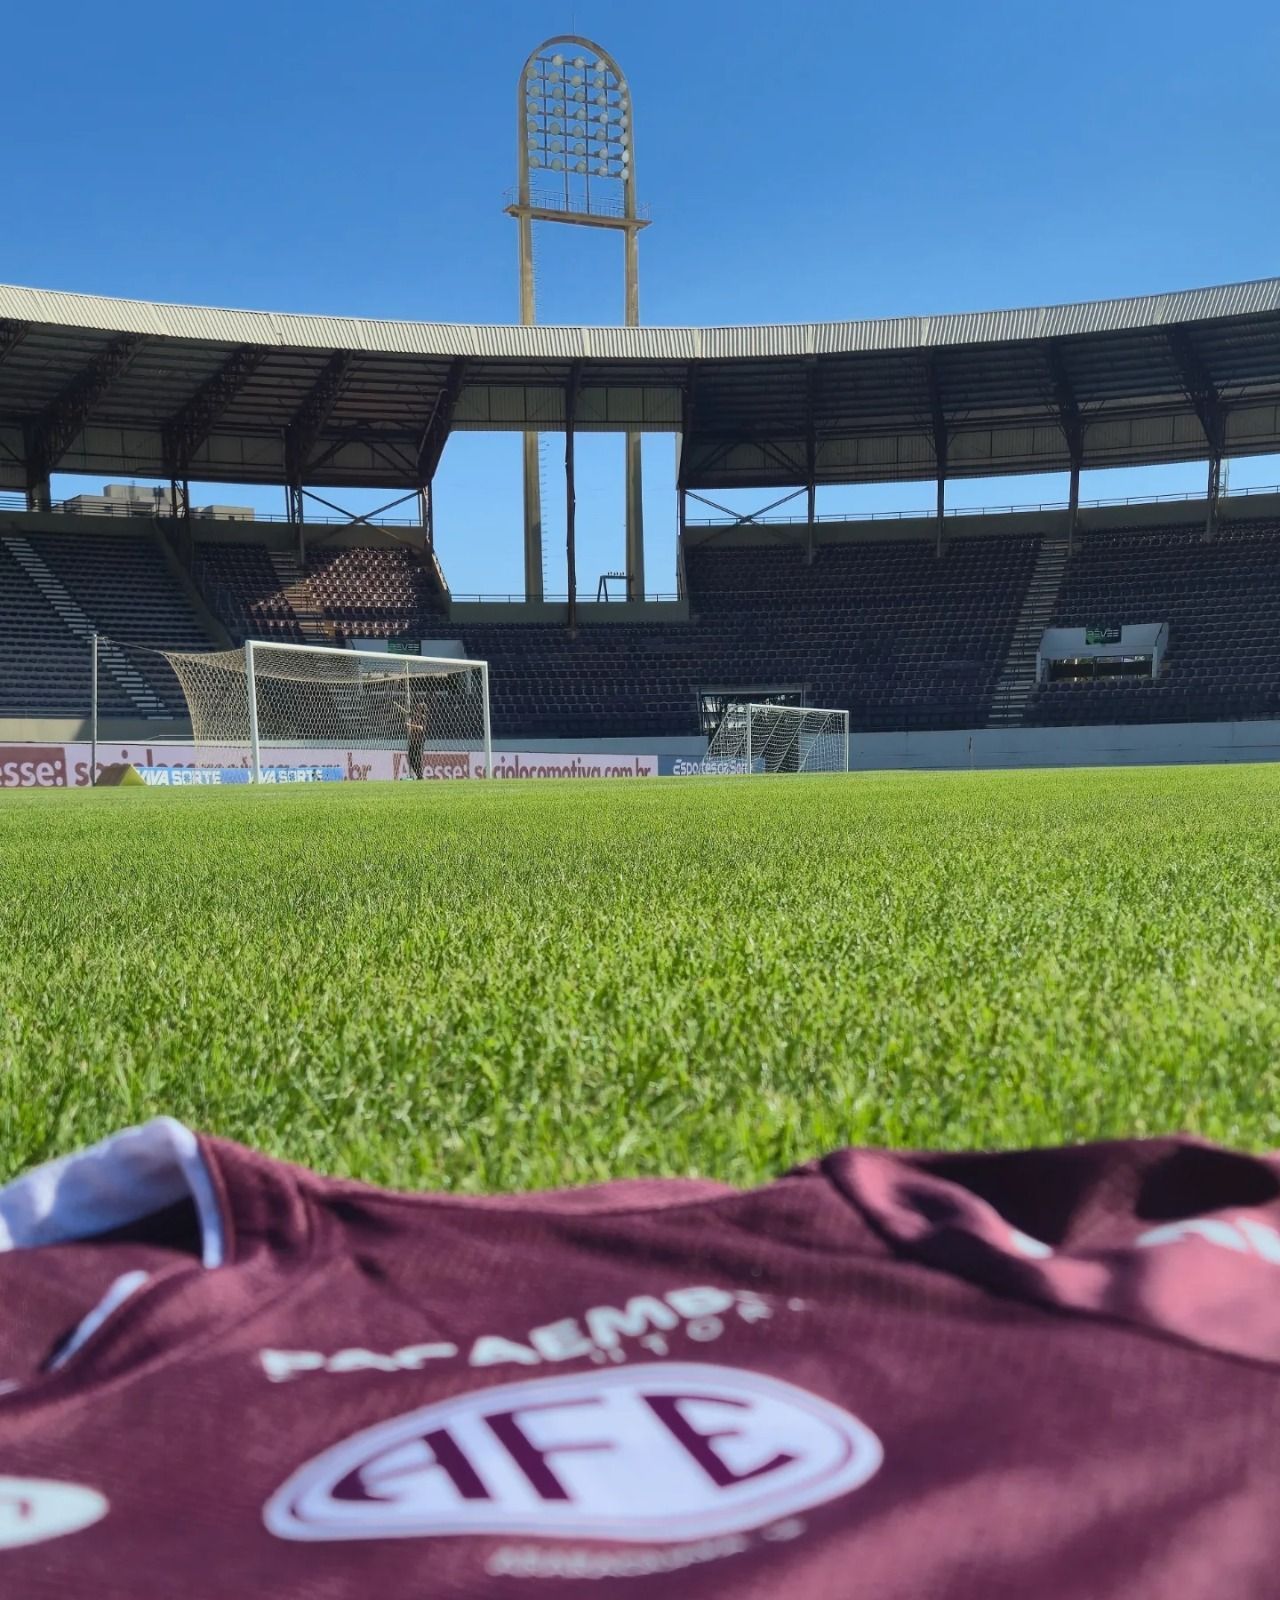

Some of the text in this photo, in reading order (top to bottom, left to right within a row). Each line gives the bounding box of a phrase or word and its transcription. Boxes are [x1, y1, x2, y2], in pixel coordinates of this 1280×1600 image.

[0, 762, 63, 787] sse:
[171, 769, 222, 785] SORTE
[330, 1394, 798, 1503] AFE
